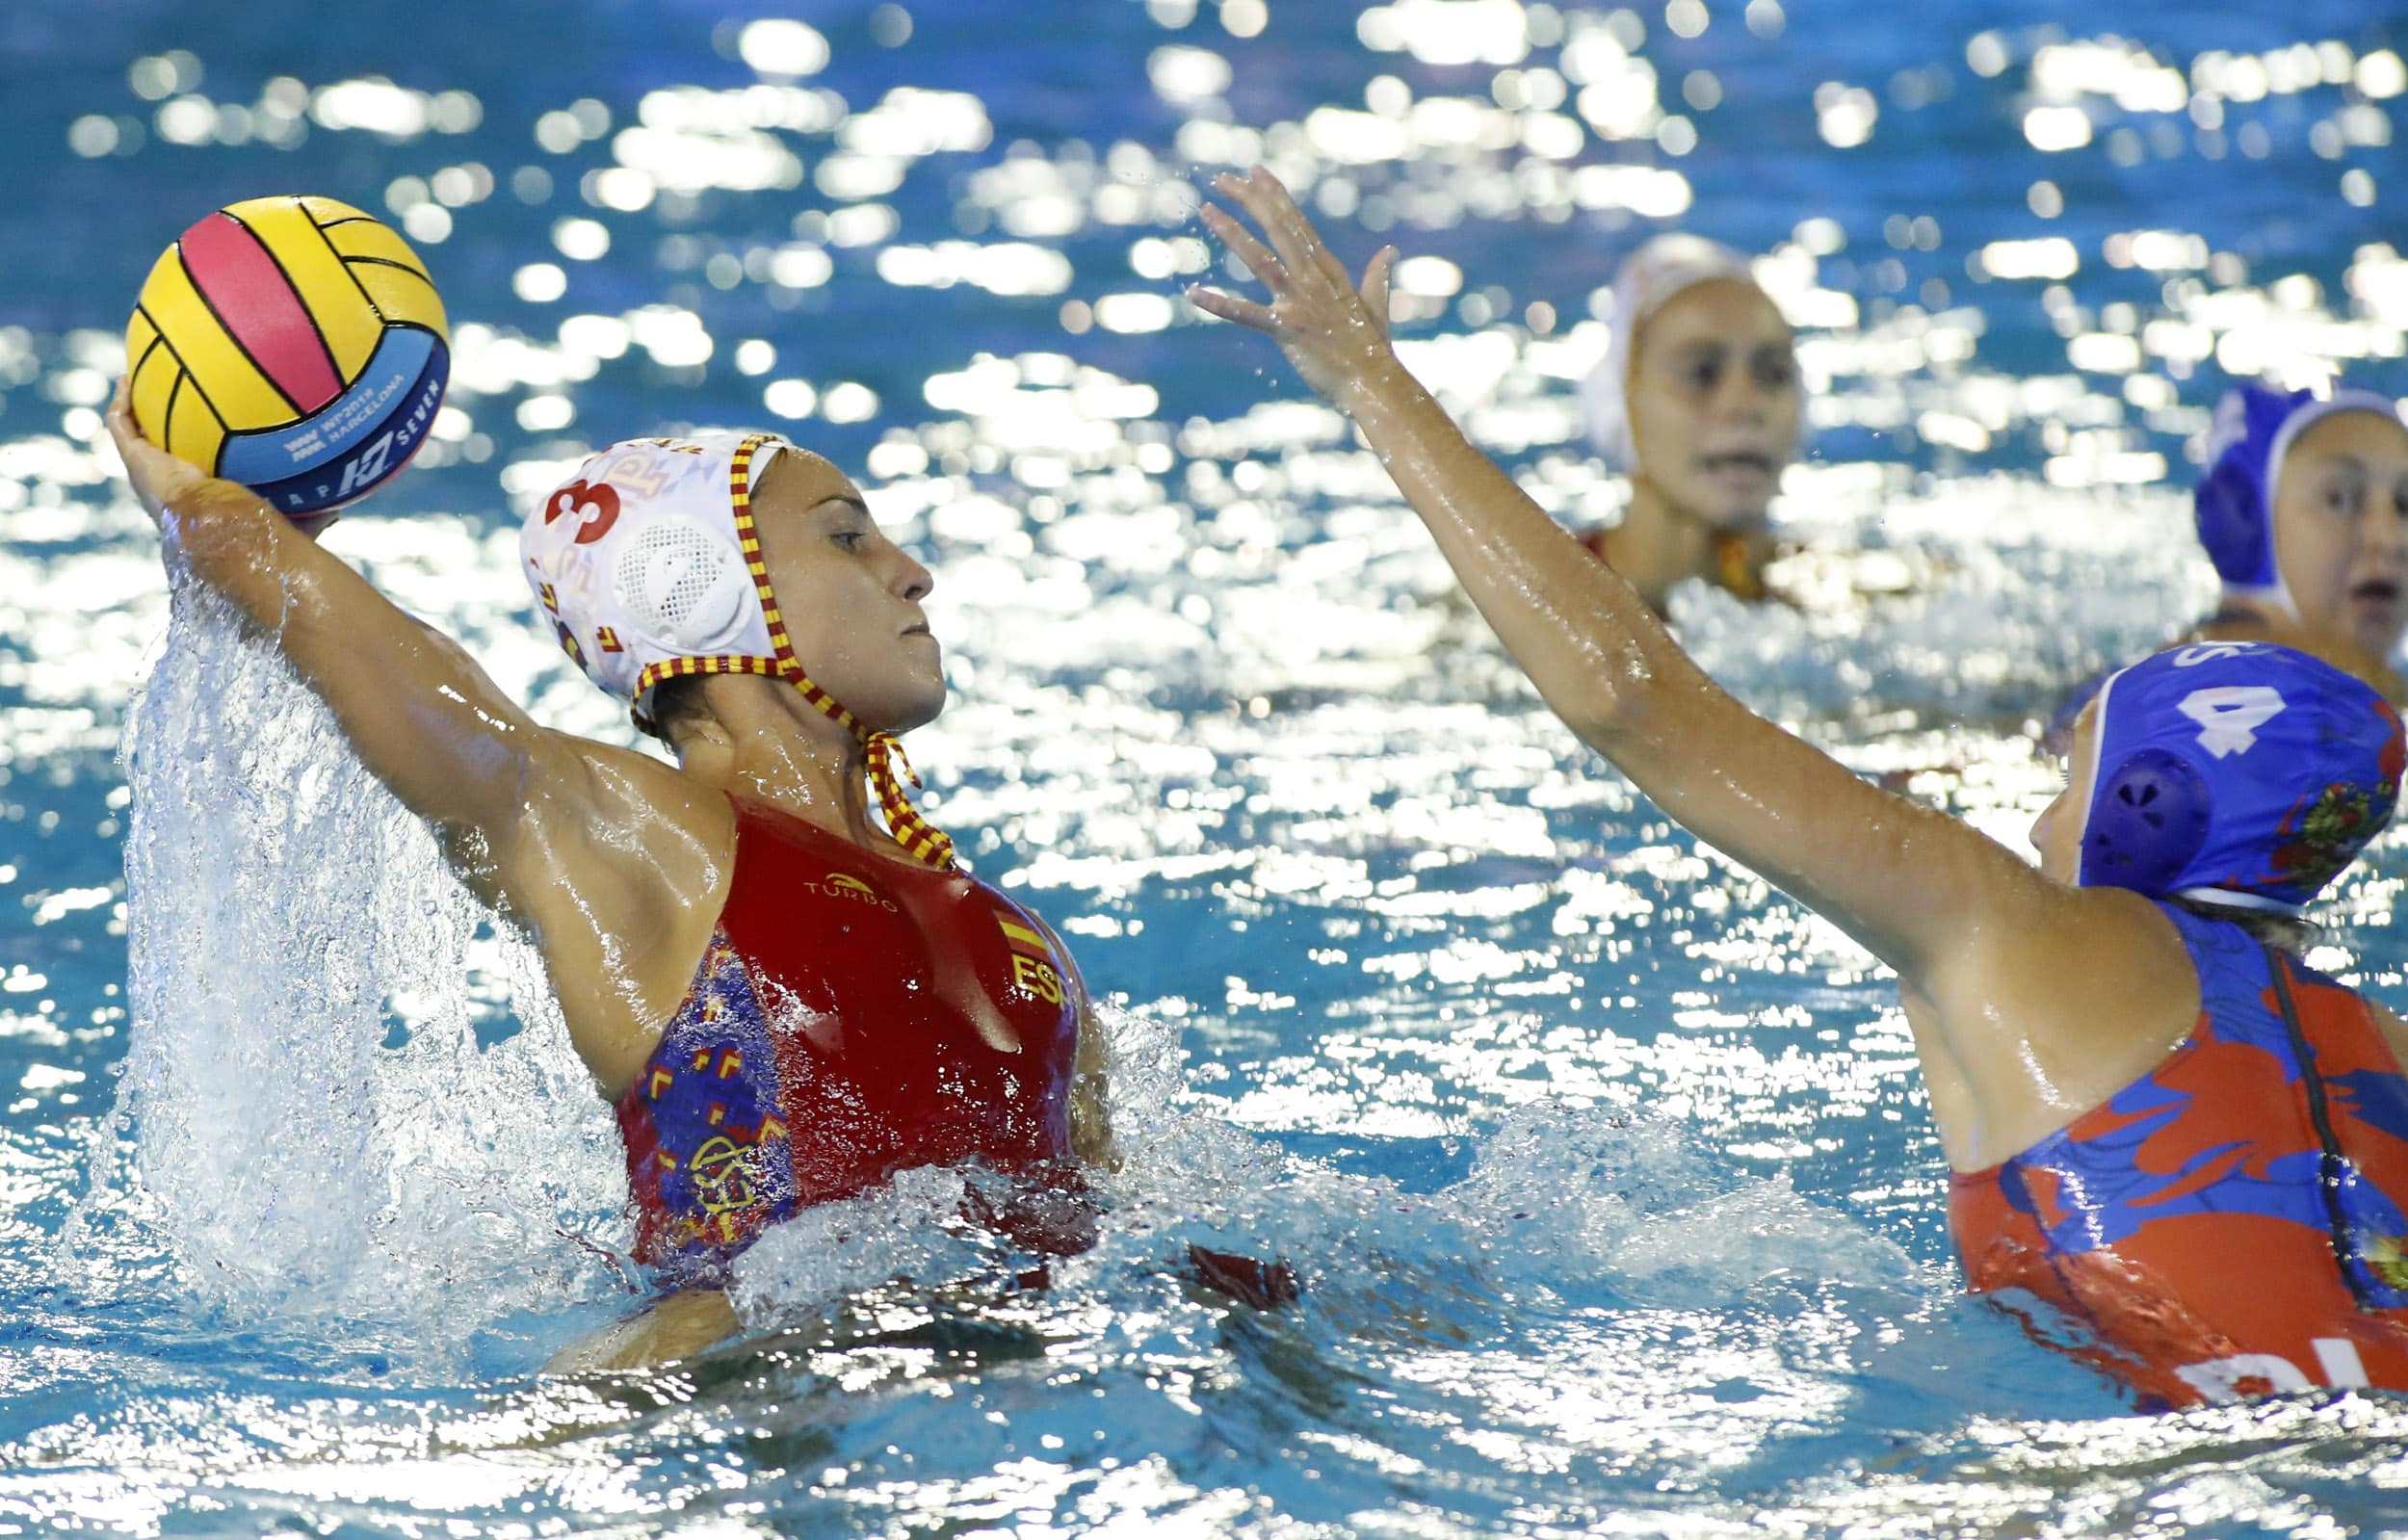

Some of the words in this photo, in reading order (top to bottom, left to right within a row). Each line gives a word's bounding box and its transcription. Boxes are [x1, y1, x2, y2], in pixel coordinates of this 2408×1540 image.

[328, 374, 405, 443] BARCELONA
[396, 379, 440, 446] SEVEN
[545, 479, 621, 544] 3
[2175, 686, 2290, 760] 4
